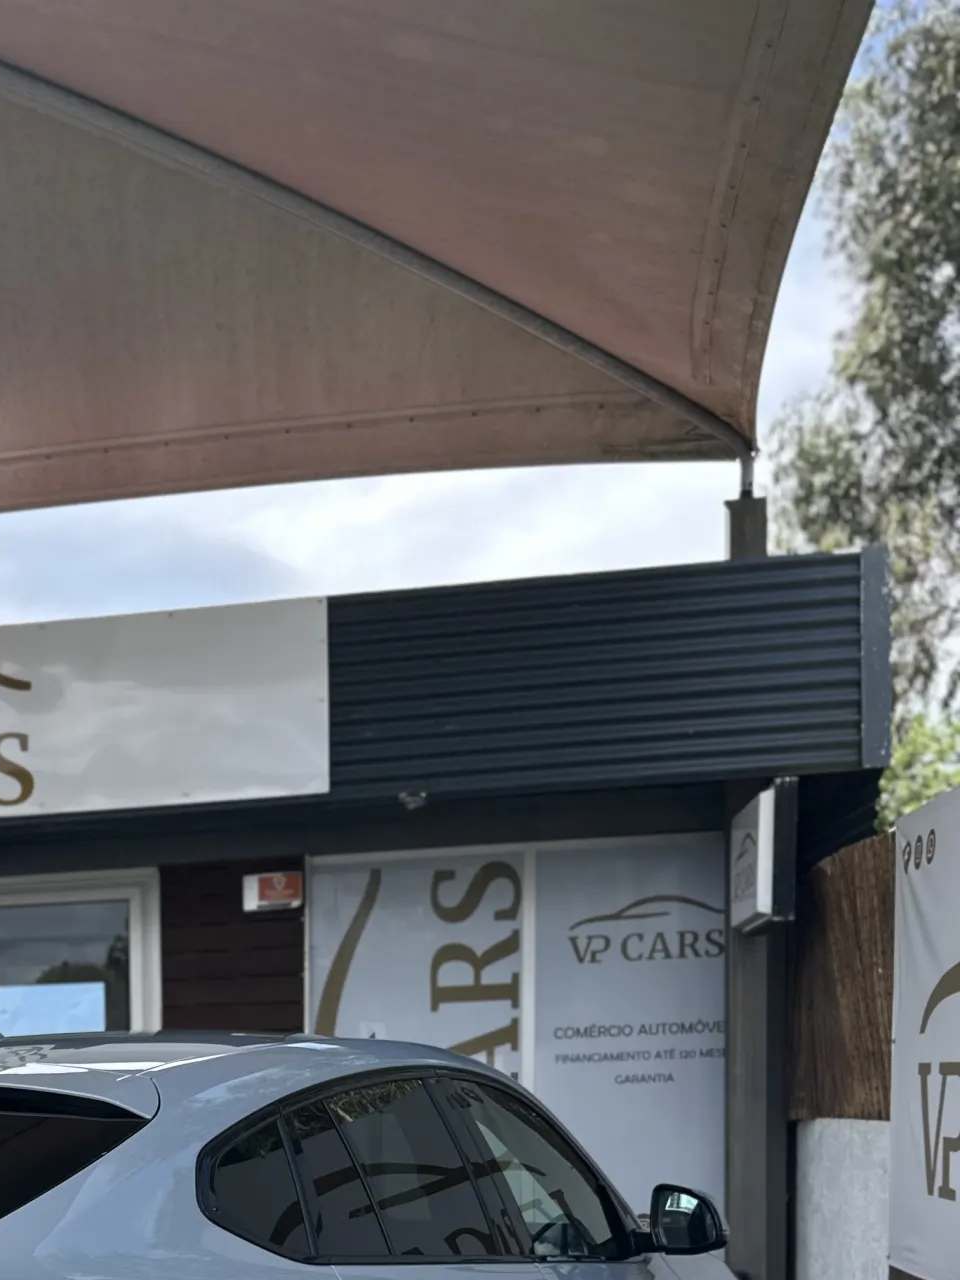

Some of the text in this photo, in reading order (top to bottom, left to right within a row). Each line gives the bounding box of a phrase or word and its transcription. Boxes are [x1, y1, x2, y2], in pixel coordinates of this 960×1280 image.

[567, 928, 725, 964] VP CARS
[553, 1023, 634, 1040] COMÉRCIO
[555, 1051, 651, 1065] FINANCIAMENTO
[614, 1072, 675, 1085] GARANTIA
